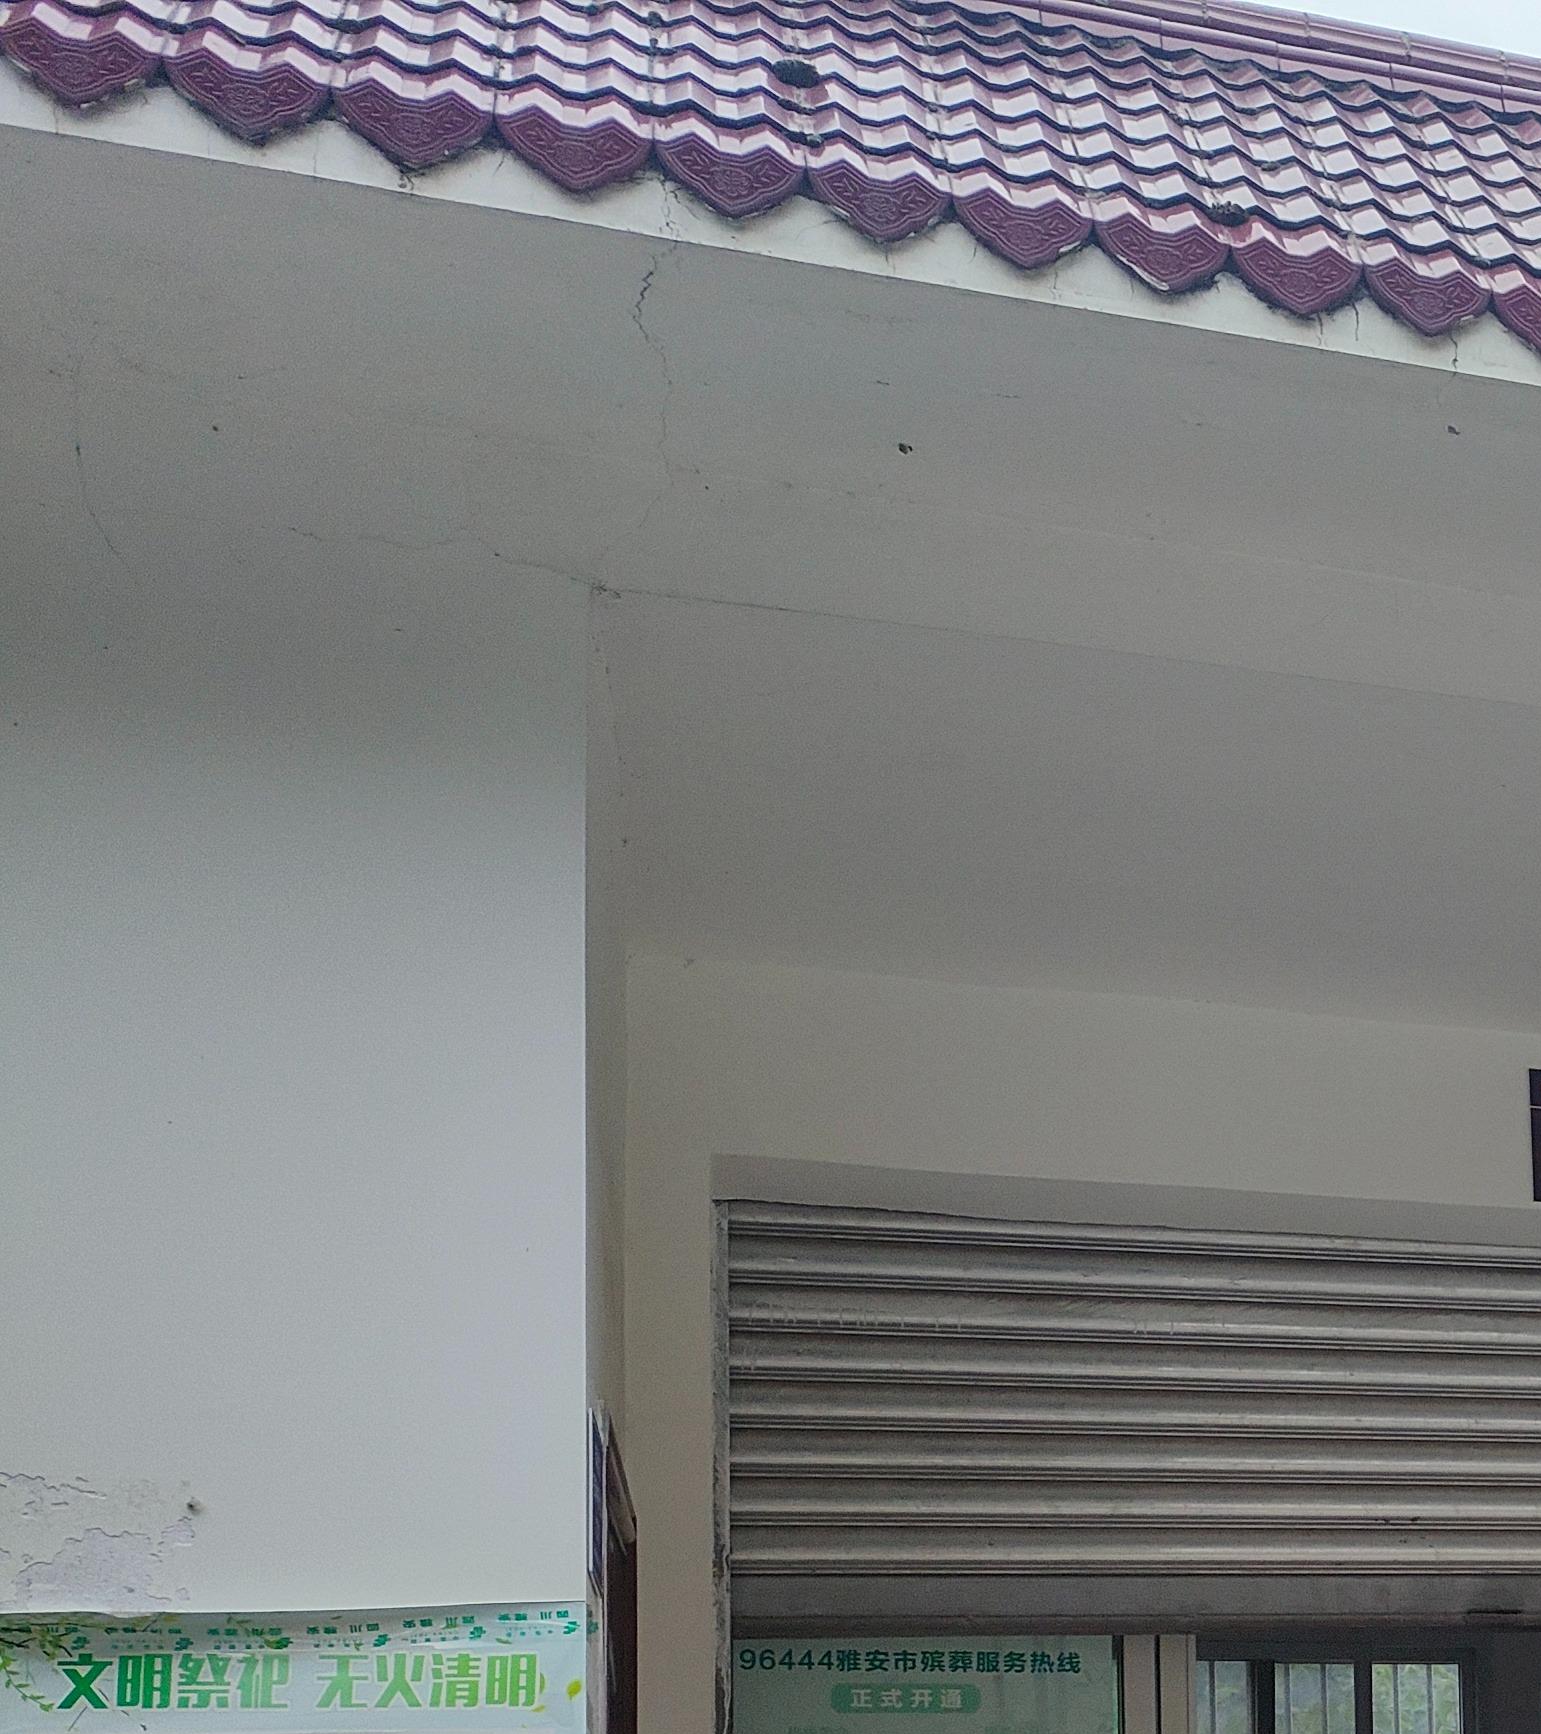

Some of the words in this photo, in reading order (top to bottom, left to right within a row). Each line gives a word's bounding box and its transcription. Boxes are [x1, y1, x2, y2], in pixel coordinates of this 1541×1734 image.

[739, 1649, 1082, 1674] 96444雅安市殡葬服务热线
[56, 1653, 290, 1710] 文明祭祀
[315, 1653, 538, 1709] 无火清明
[850, 1688, 964, 1709] 正式开通
